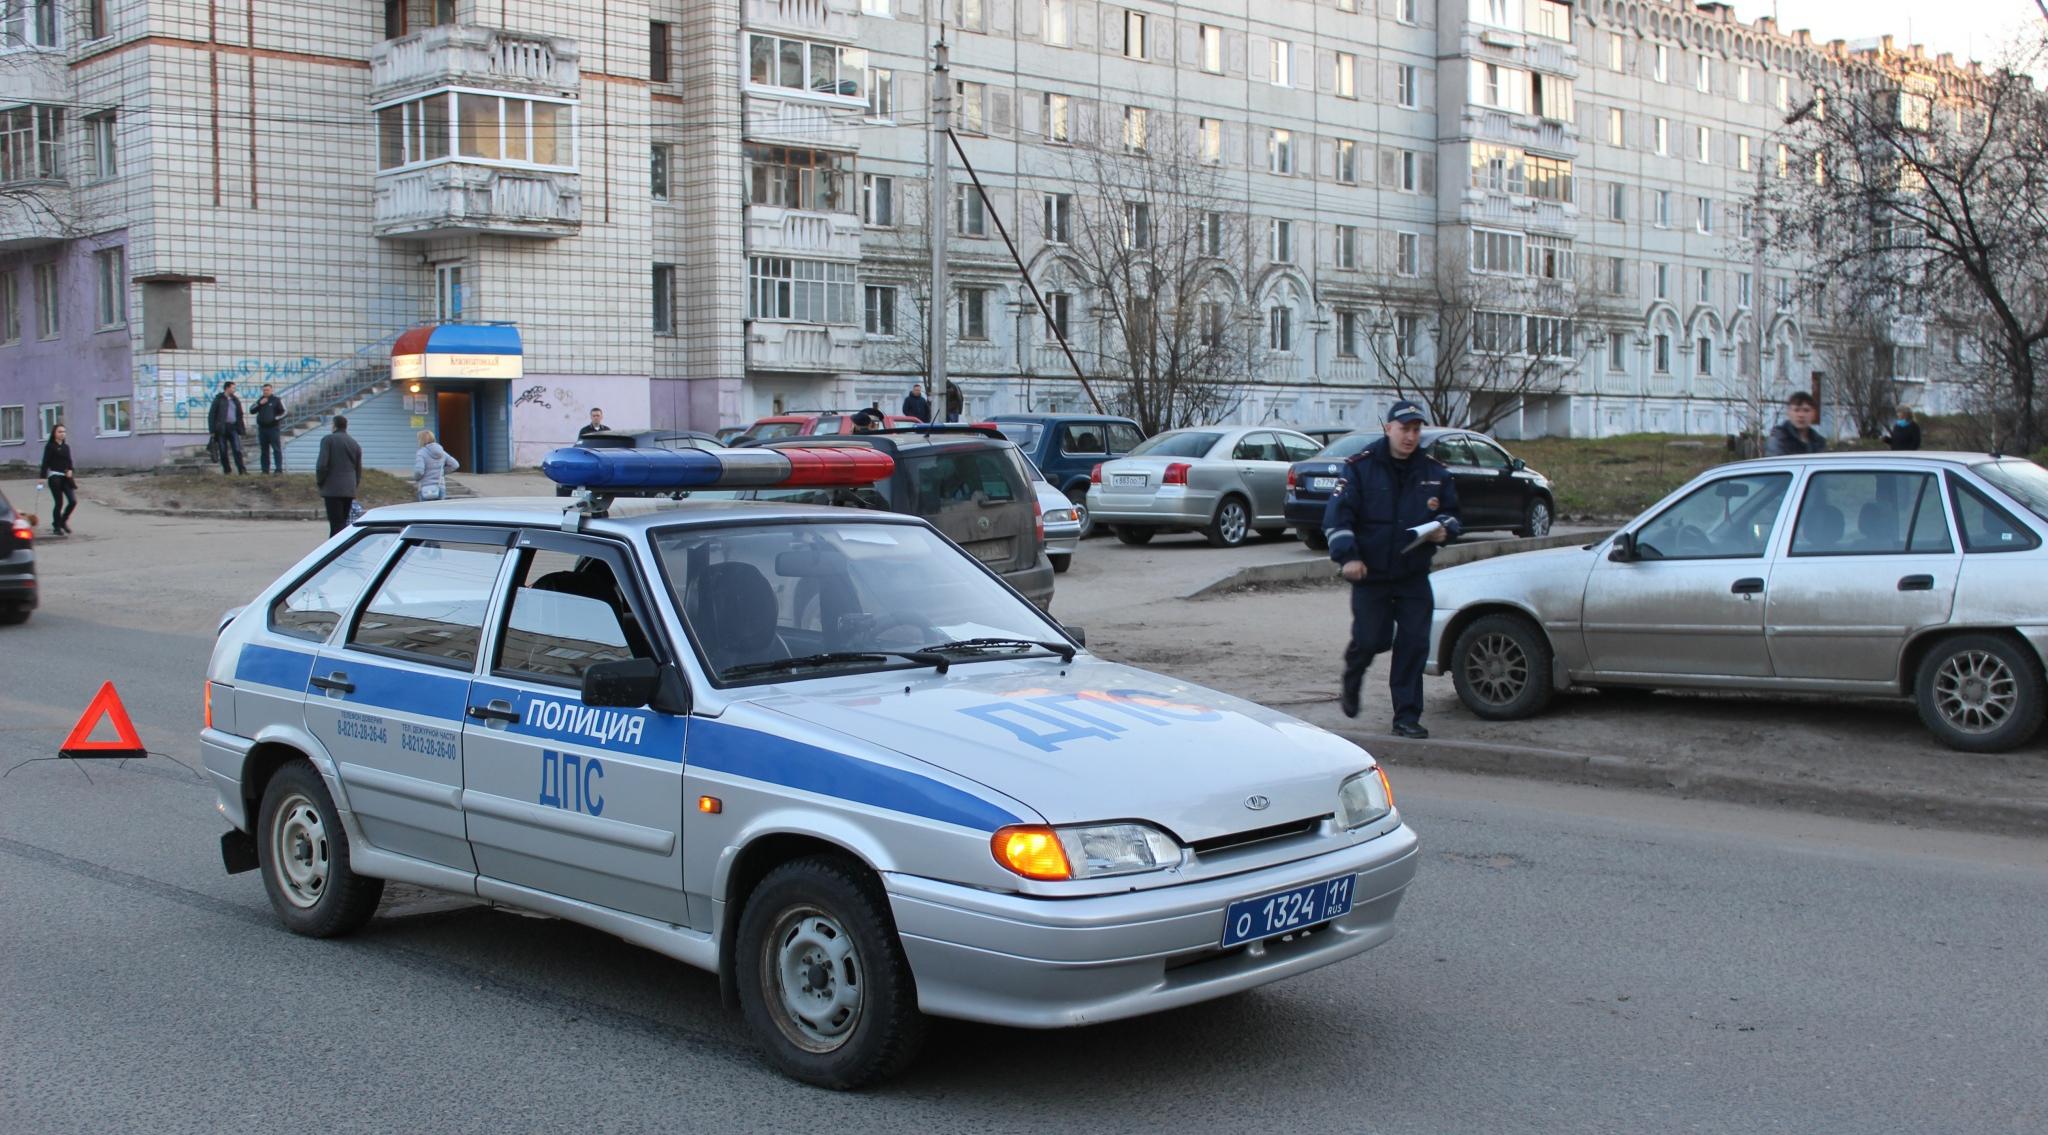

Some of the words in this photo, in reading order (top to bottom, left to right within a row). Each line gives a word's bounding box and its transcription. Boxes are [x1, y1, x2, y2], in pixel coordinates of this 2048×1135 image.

[337, 719, 388, 744] 8-8212-28-26-46
[440, 731, 456, 740] ЧАСТИ
[526, 698, 646, 745] ПОЛИЦИЯ
[956, 688, 1223, 752] ДПС
[401, 733, 456, 760] 8-8212-28-26-00
[540, 749, 605, 817] ДПС
[1263, 888, 1315, 932] 1324
[1329, 878, 1349, 904] 11
[1327, 904, 1343, 915] RUS
